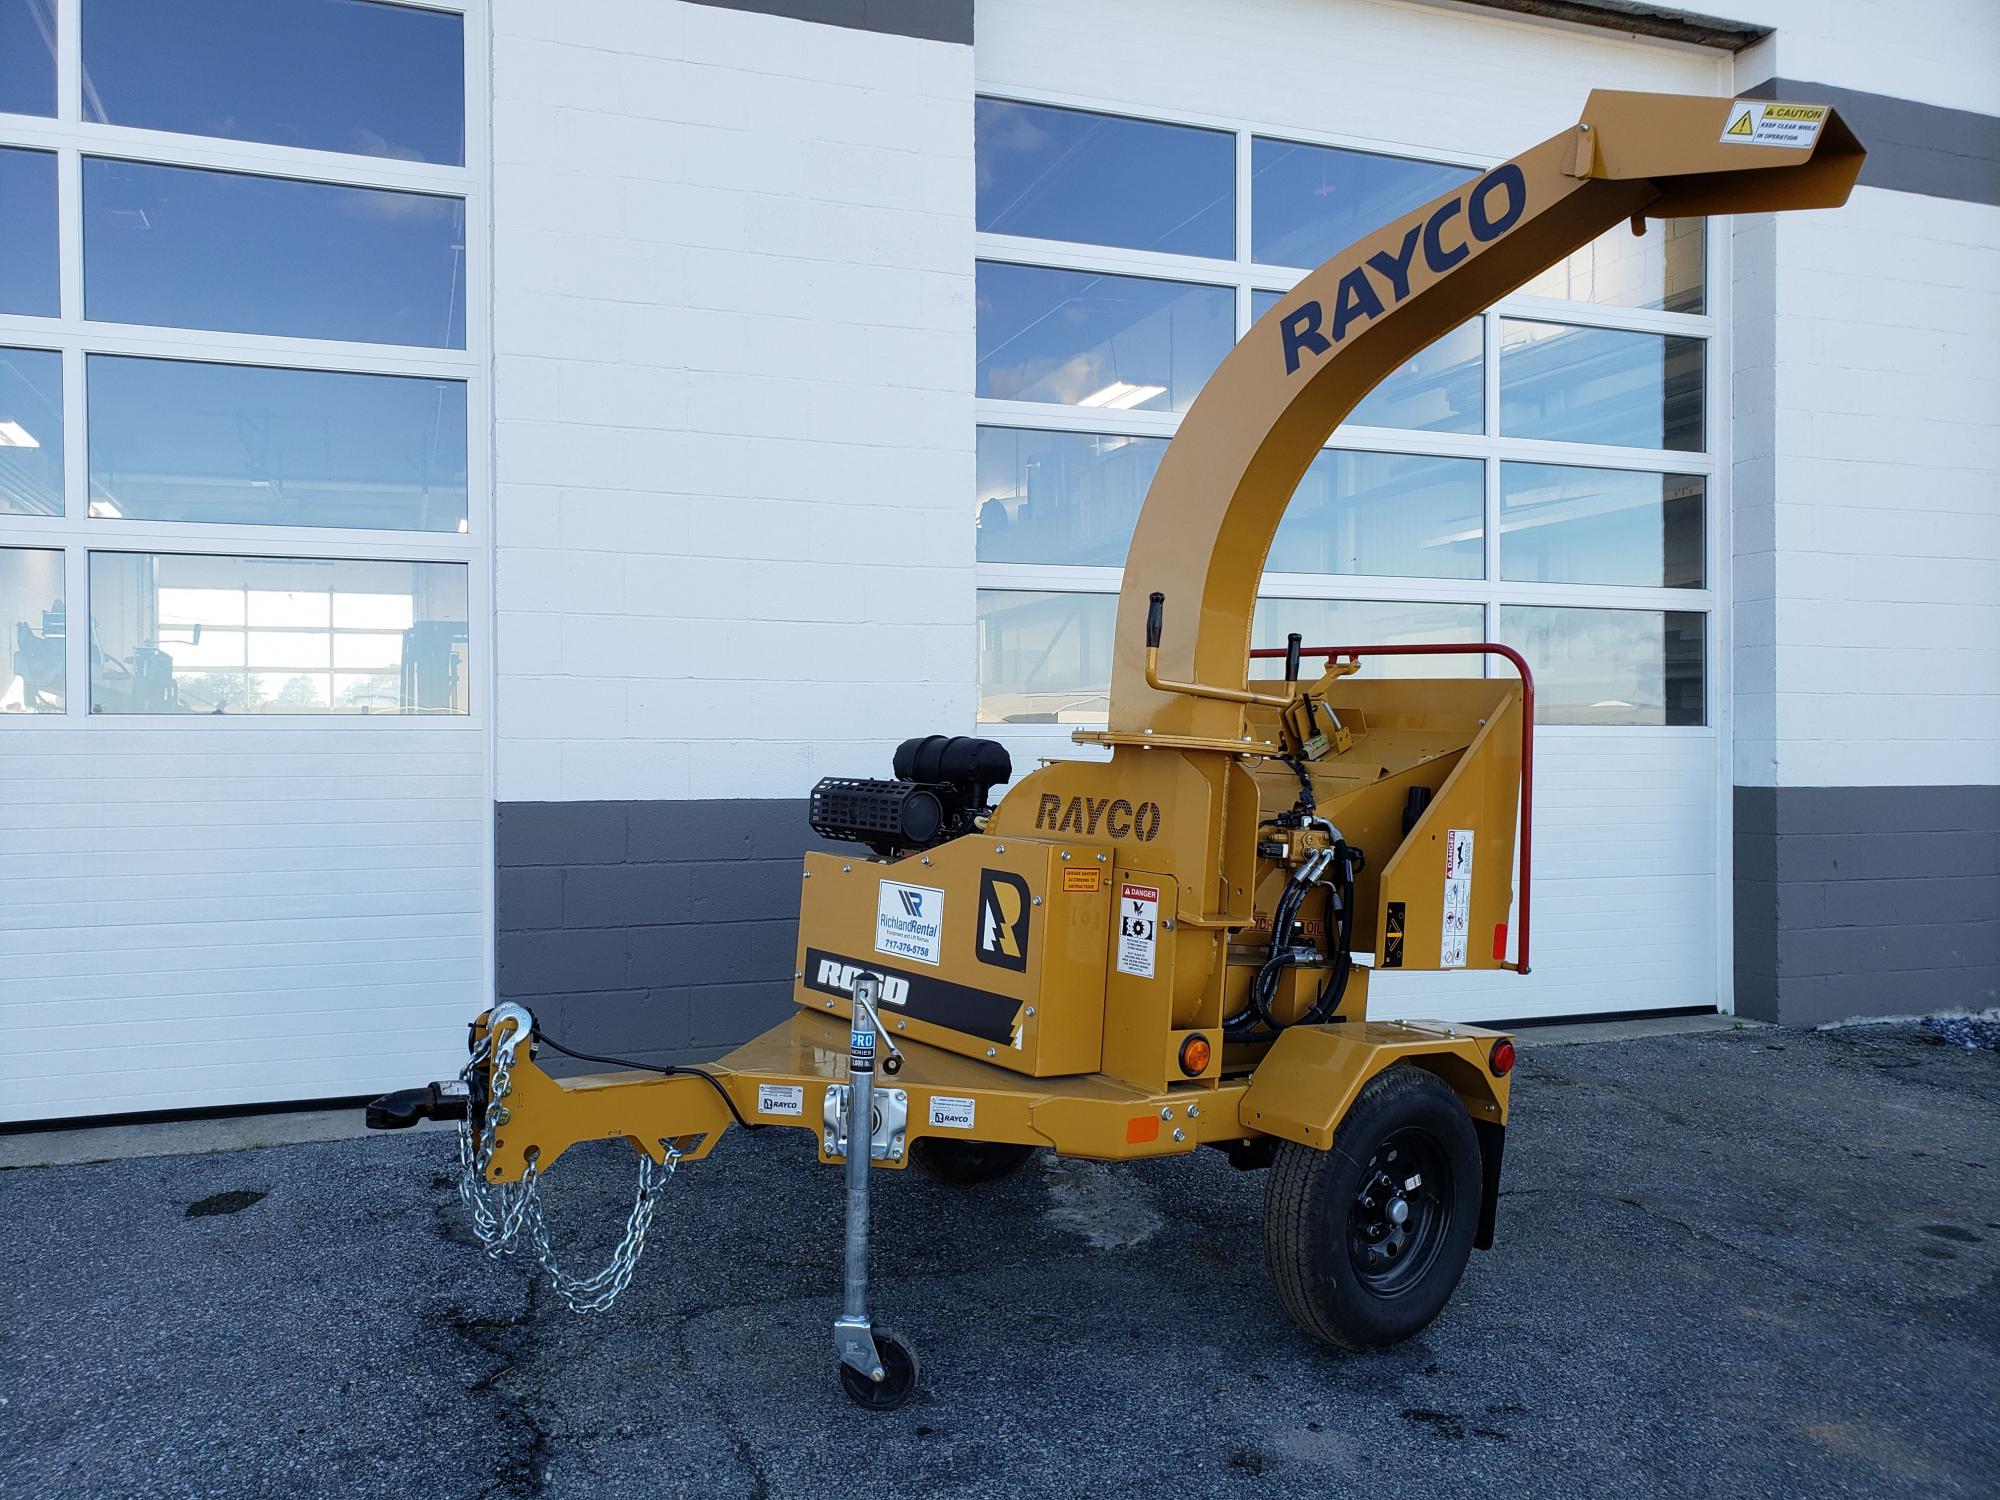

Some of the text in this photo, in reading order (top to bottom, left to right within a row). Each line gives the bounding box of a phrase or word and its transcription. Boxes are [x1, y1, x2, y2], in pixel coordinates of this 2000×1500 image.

[1776, 108, 1823, 119] CAUTION
[1279, 163, 1527, 376] RAYCO
[1035, 793, 1160, 841] RAYCO
[1447, 831, 1455, 868] DANGER
[1131, 888, 1156, 899] DANGER
[1306, 921, 1323, 934] OIL
[885, 939, 930, 957] 717-376-5758
[851, 1033, 873, 1047] PRO
[773, 1101, 797, 1109] RAYCO
[944, 1115, 969, 1123] RAYCO
